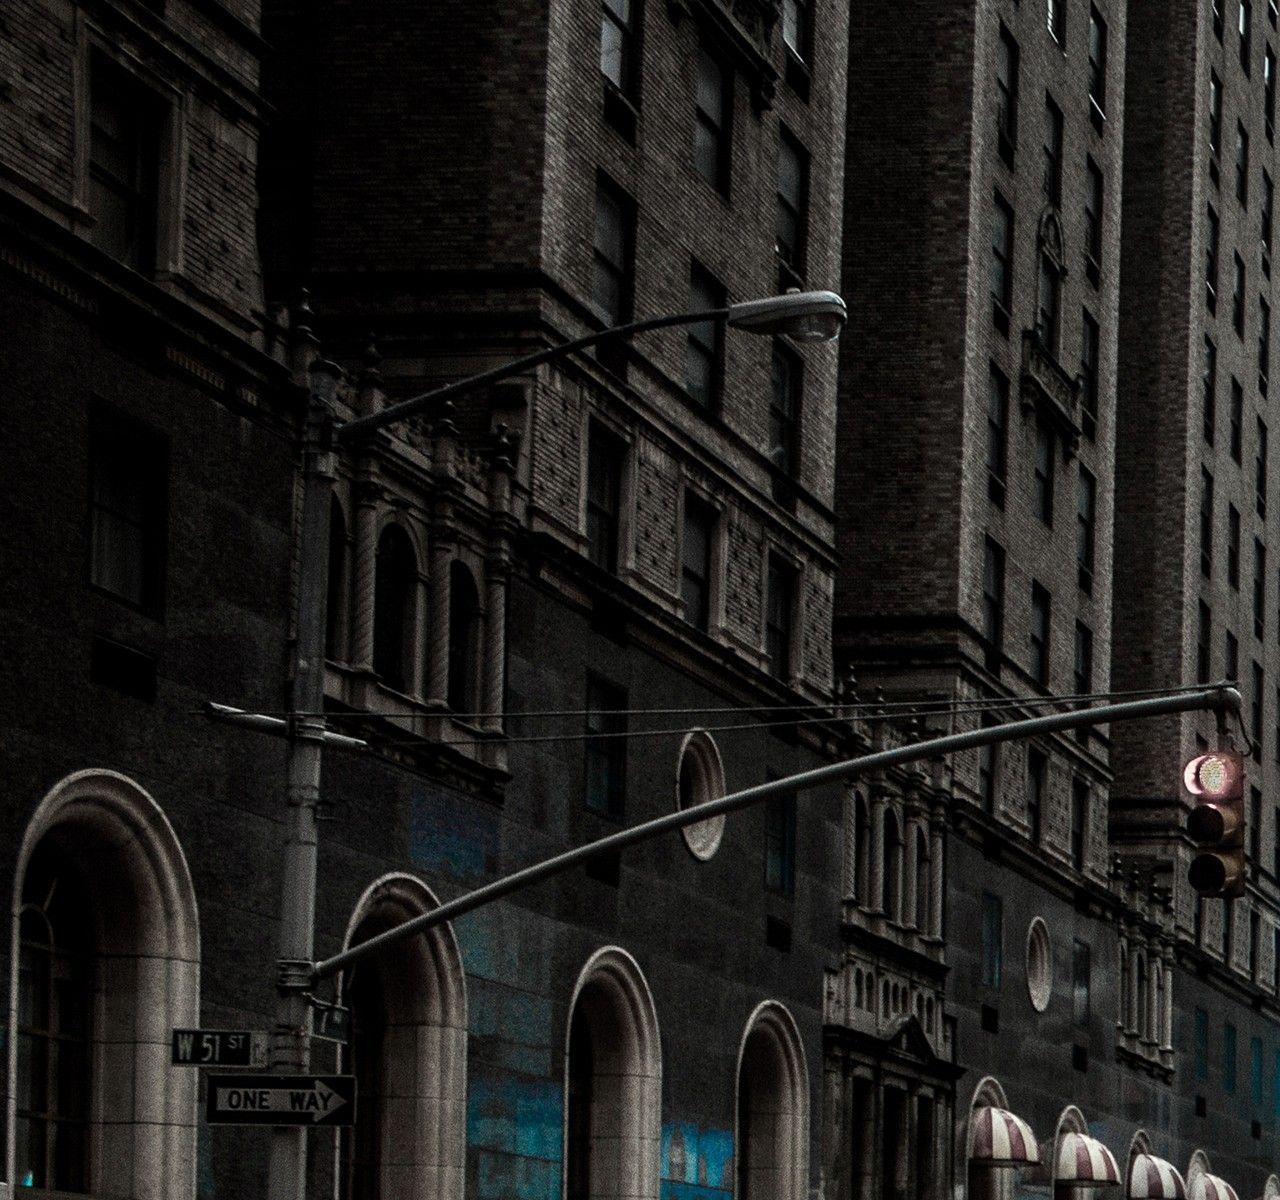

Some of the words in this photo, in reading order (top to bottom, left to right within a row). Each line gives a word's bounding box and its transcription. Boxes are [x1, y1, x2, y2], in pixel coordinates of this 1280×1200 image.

[177, 1033, 194, 1061] W
[201, 1034, 220, 1062] 51
[228, 1036, 244, 1049] ST
[228, 1091, 270, 1109] ONE
[290, 1092, 333, 1111] WAY
